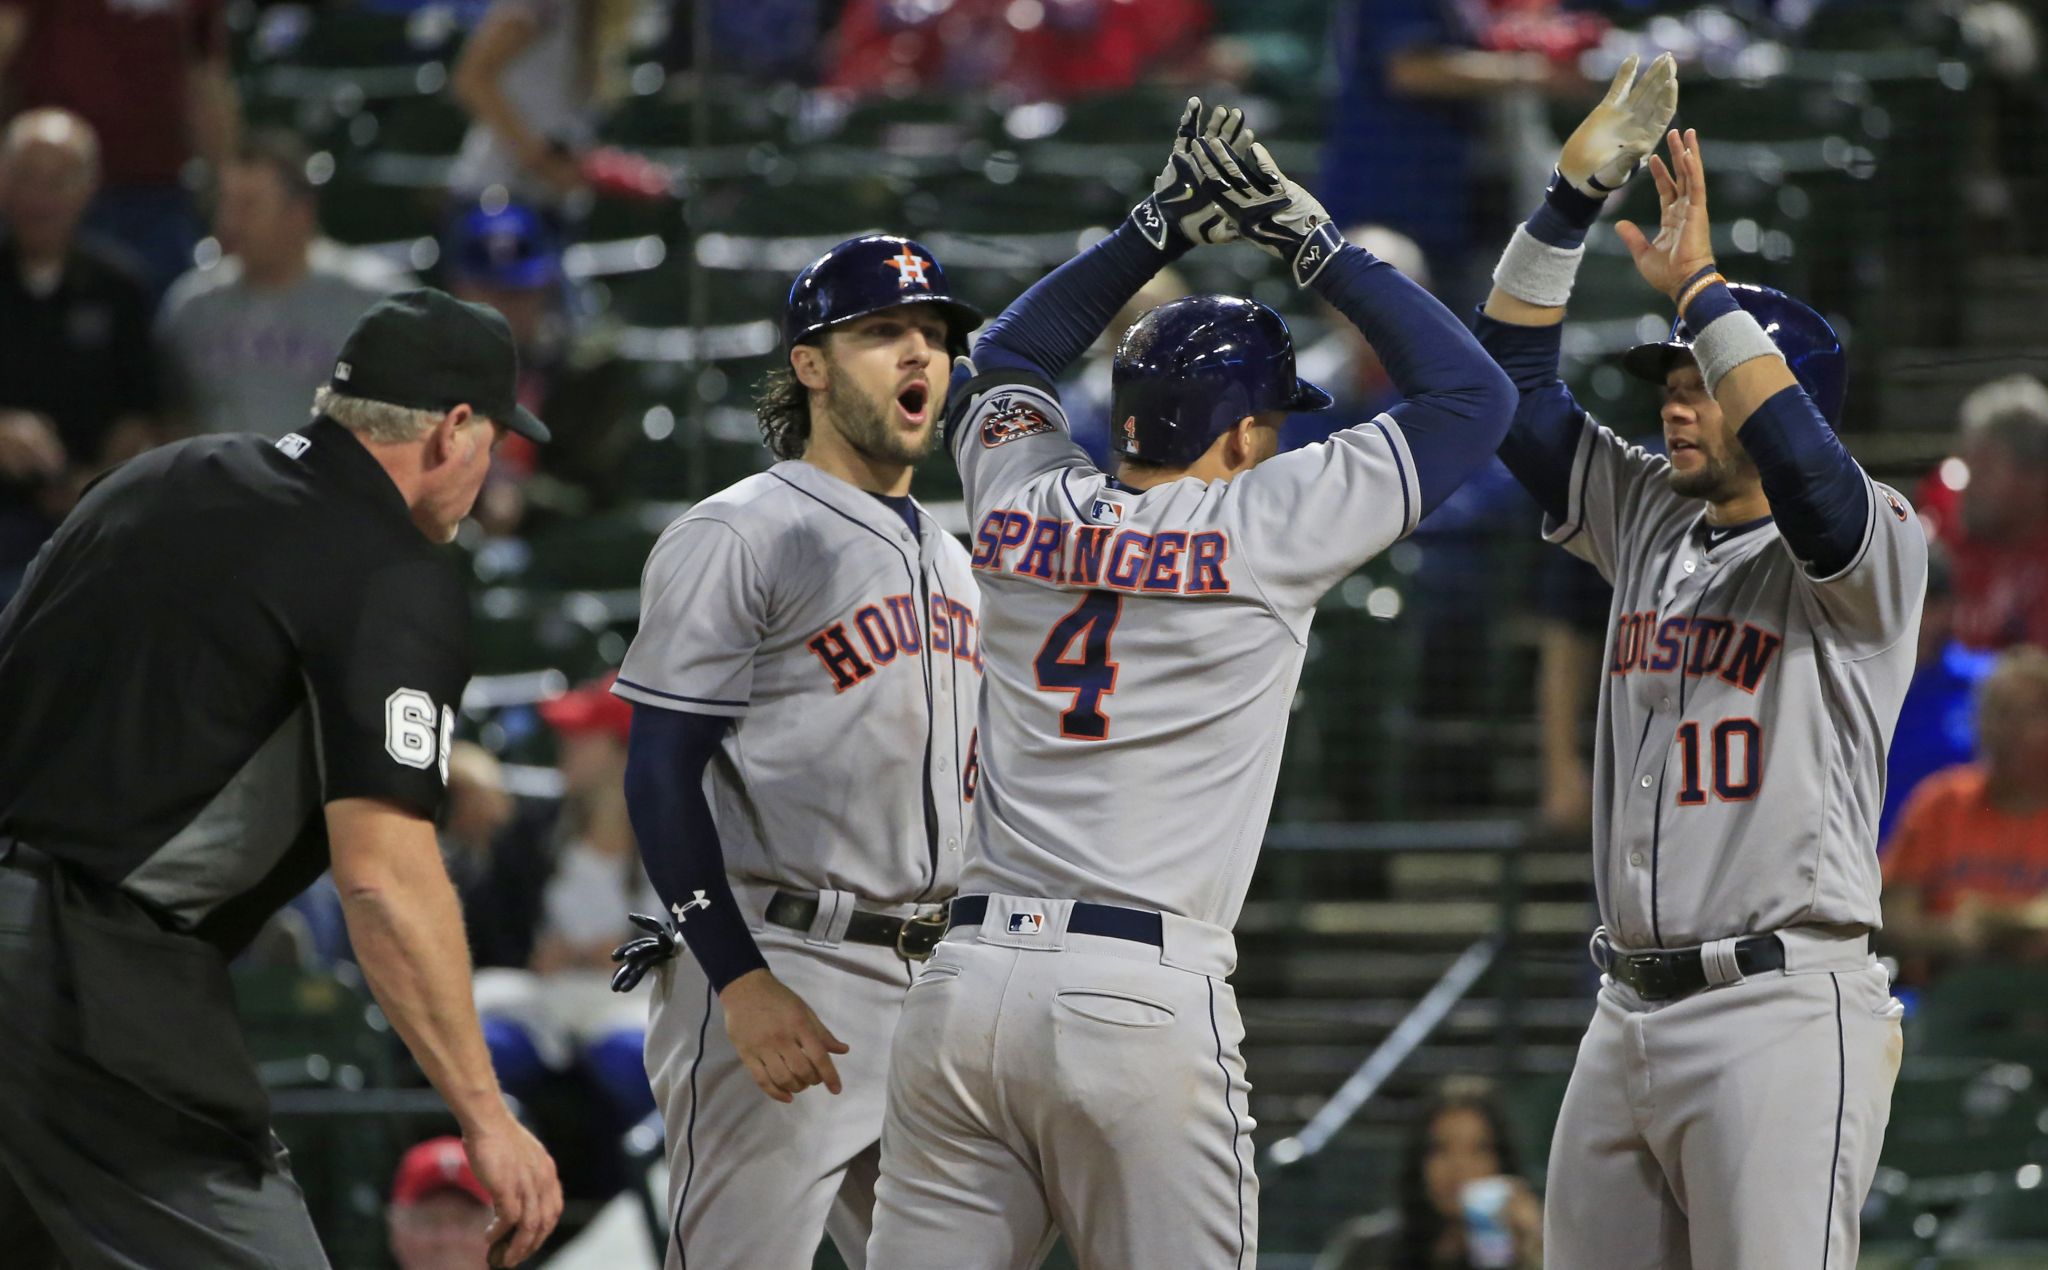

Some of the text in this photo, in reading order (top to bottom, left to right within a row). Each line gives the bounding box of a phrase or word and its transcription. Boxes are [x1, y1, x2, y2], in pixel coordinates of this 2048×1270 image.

[892, 254, 929, 284] H
[1123, 415, 1136, 439] 4
[970, 509, 1231, 595] SPRINGER
[805, 591, 986, 694] HOUST
[1032, 590, 1124, 741] 4
[1675, 716, 1764, 807] 10
